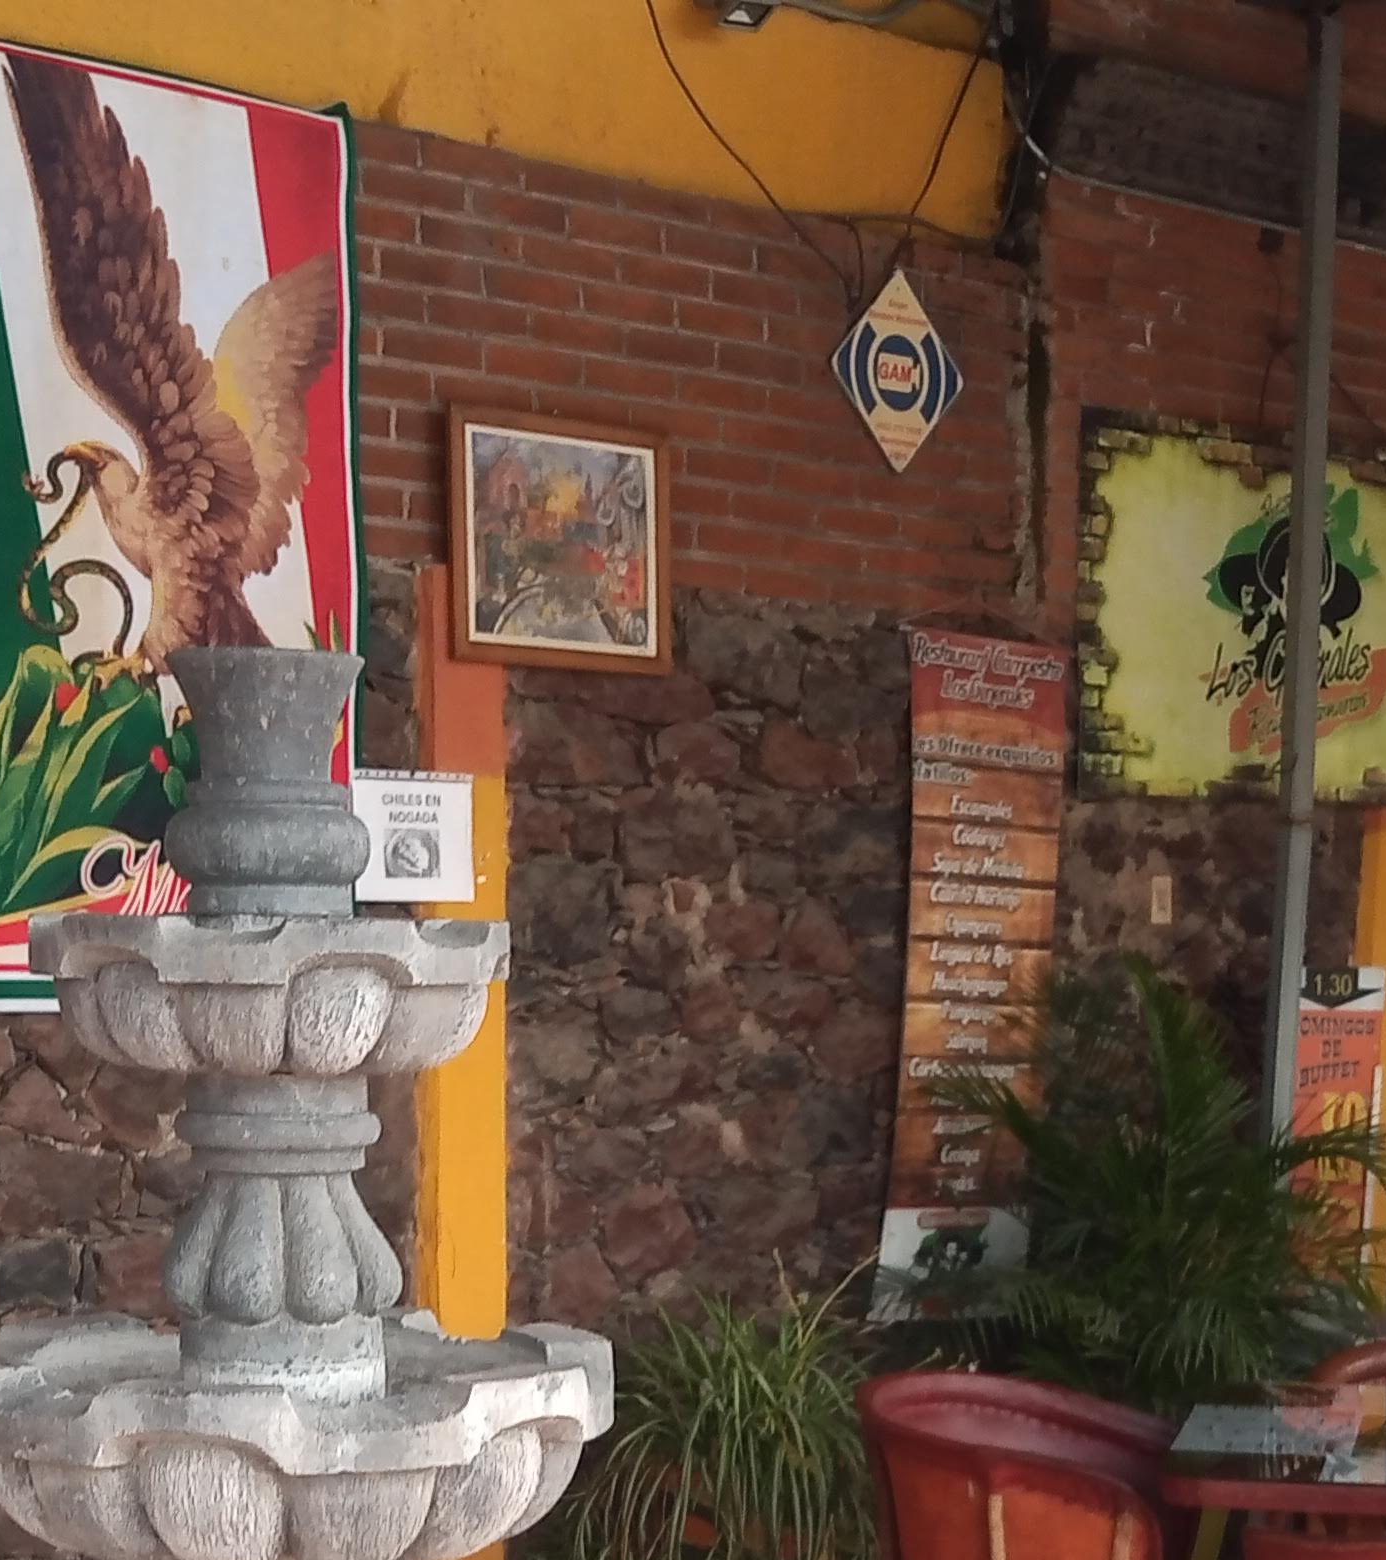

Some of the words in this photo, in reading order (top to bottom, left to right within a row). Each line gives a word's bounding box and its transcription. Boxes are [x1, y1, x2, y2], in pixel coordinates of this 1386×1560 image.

[878, 361, 912, 384] GAM
[1206, 642, 1257, 702] Los
[381, 793, 423, 806] CHILES
[425, 794, 441, 807] EN
[388, 811, 439, 824] NOGADA
[1299, 1015, 1375, 1036] OMINGOS
[1322, 1039, 1342, 1058] DE
